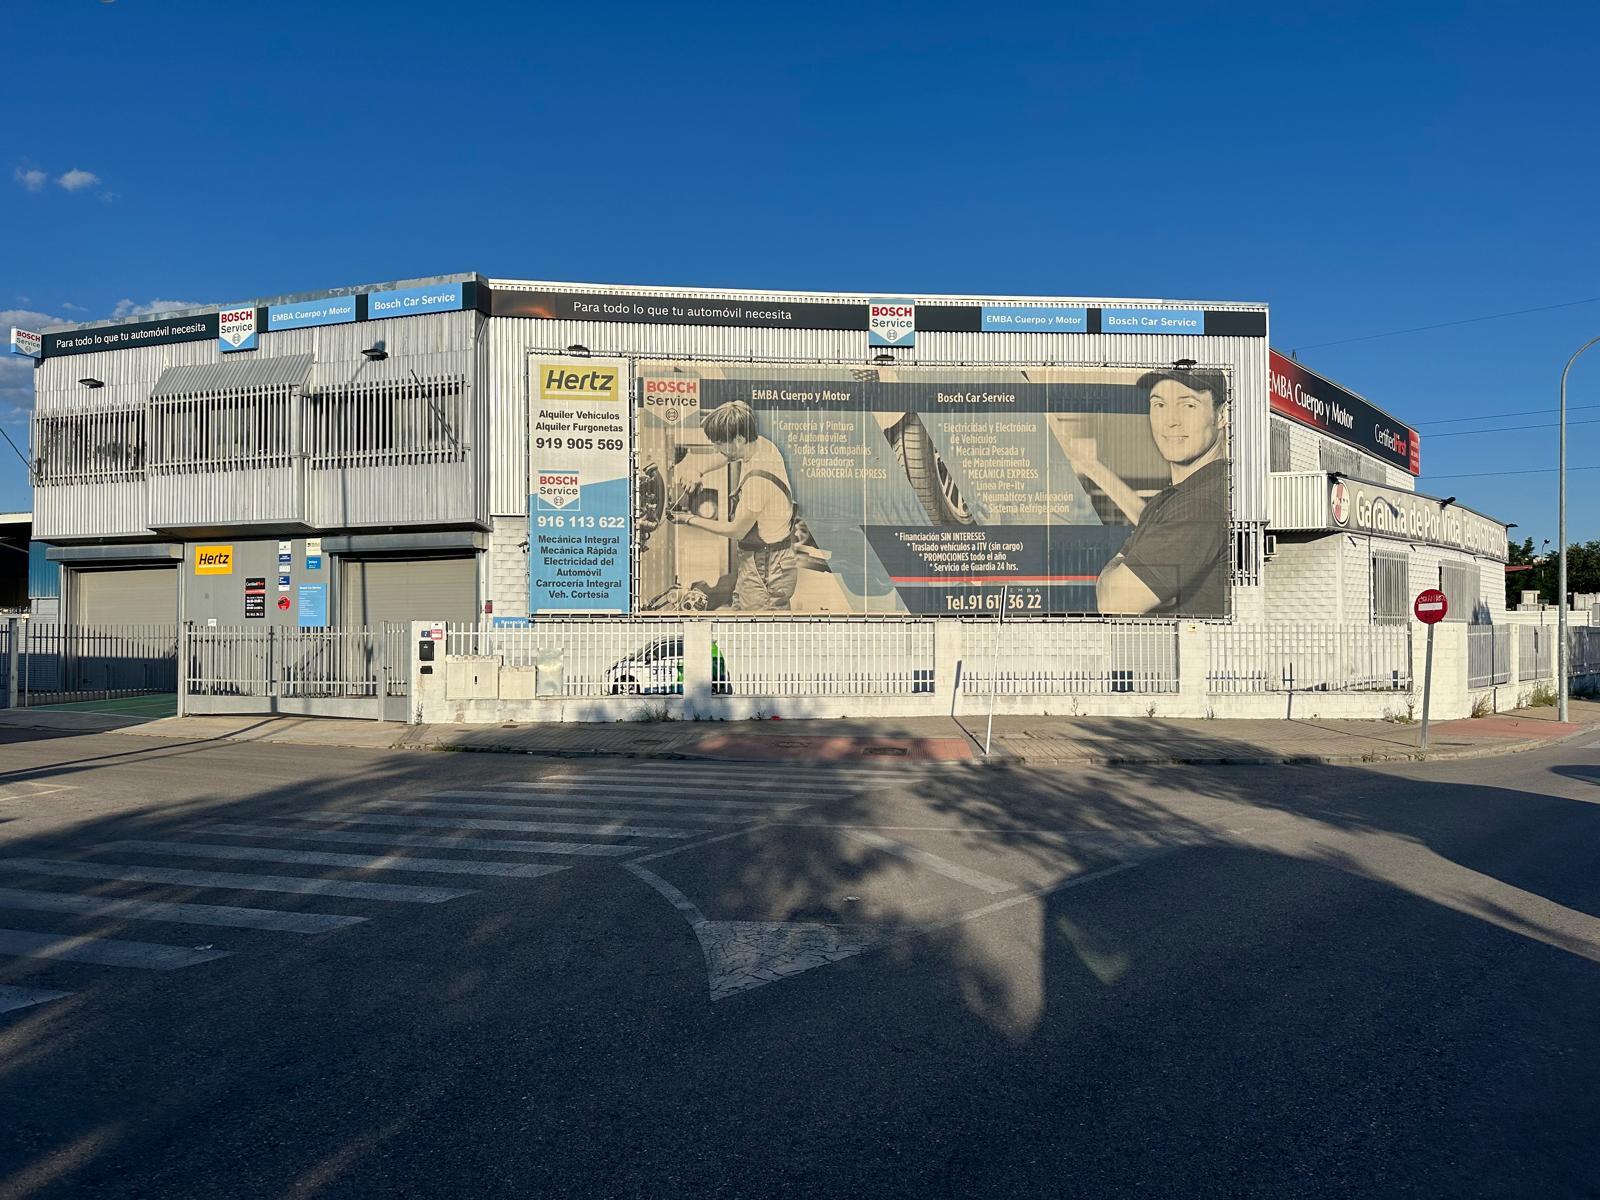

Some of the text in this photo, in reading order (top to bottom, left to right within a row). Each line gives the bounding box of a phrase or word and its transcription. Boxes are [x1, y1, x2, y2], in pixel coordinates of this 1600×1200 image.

[374, 293, 456, 311] Bosch Car Service
[272, 306, 352, 322] EMBA Cuerpo y Motor
[573, 301, 792, 320] Para todo lo que tu automóvil necesita
[872, 306, 913, 318] BOSCH
[221, 310, 253, 323] BOSCH
[986, 315, 1082, 326] EMBA Cuerpo y Motor
[1108, 316, 1197, 328] Bosch Car Service
[221, 322, 253, 334] Service
[872, 318, 913, 328] Service
[16, 330, 41, 342] BOSCH
[56, 323, 206, 349] Para todo lo que tu automóvil necesita
[16, 338, 41, 347] Service
[545, 369, 614, 391] Hertz
[646, 381, 697, 394] BOSCH
[646, 395, 697, 407] Service
[752, 389, 851, 403] EMBA Cuerpo y Motor
[937, 392, 1015, 403] Bosch Car Service
[1295, 383, 1324, 420] Cuerpo
[1325, 402, 1331, 425] y
[1331, 401, 1354, 430] Motor
[538, 410, 575, 420] Alquiler
[535, 423, 623, 434] Alquiler Furgonetas
[826, 420, 854, 431] Pintura
[943, 422, 1037, 433] Electricidad y Electrónica
[788, 432, 798, 442] de
[950, 434, 960, 443] de
[536, 437, 623, 450] 919 905 569
[794, 445, 816, 455] Todas
[817, 444, 828, 455] las
[992, 446, 1019, 455] Pesada
[1020, 447, 1025, 456] y
[802, 457, 854, 467] Aseguradoras
[962, 458, 1031, 467] de Mantenimiento
[855, 468, 887, 479] EXPRESS
[968, 468, 1039, 479] MECÁNICA EXPRESS
[539, 476, 578, 485] BOSCH
[540, 486, 578, 495] Service
[982, 492, 1074, 503] Neumáticos y Alineación
[989, 503, 1070, 514] Sistema Refrigeración
[537, 516, 625, 528] 916 113 622
[1356, 490, 1407, 533] Garantía
[1410, 502, 1423, 537] de
[1424, 505, 1441, 540] Por
[1441, 508, 1461, 543] Vida
[538, 535, 620, 545] Mecánica Integral
[899, 532, 986, 541] Financiación SIN INTERESES
[540, 545, 618, 556] Mecánica Rápida
[912, 542, 939, 551] Traslado
[940, 542, 970, 551] vehículos
[976, 542, 987, 551] ITV
[988, 542, 1001, 552] (sin
[1003, 542, 1024, 552] cargo)
[198, 553, 229, 565] Hertz
[544, 557, 614, 566] Electricidad del
[923, 552, 1007, 562] PROMOCIONES todo el año
[556, 568, 602, 577] Automóvil
[934, 562, 1019, 572] Servicio de Guardia 24 hrs.
[586, 579, 622, 589] Integral
[548, 590, 569, 599] Veh.
[986, 594, 1001, 610] 61
[1008, 594, 1024, 609] 36
[1027, 594, 1042, 609] 22
